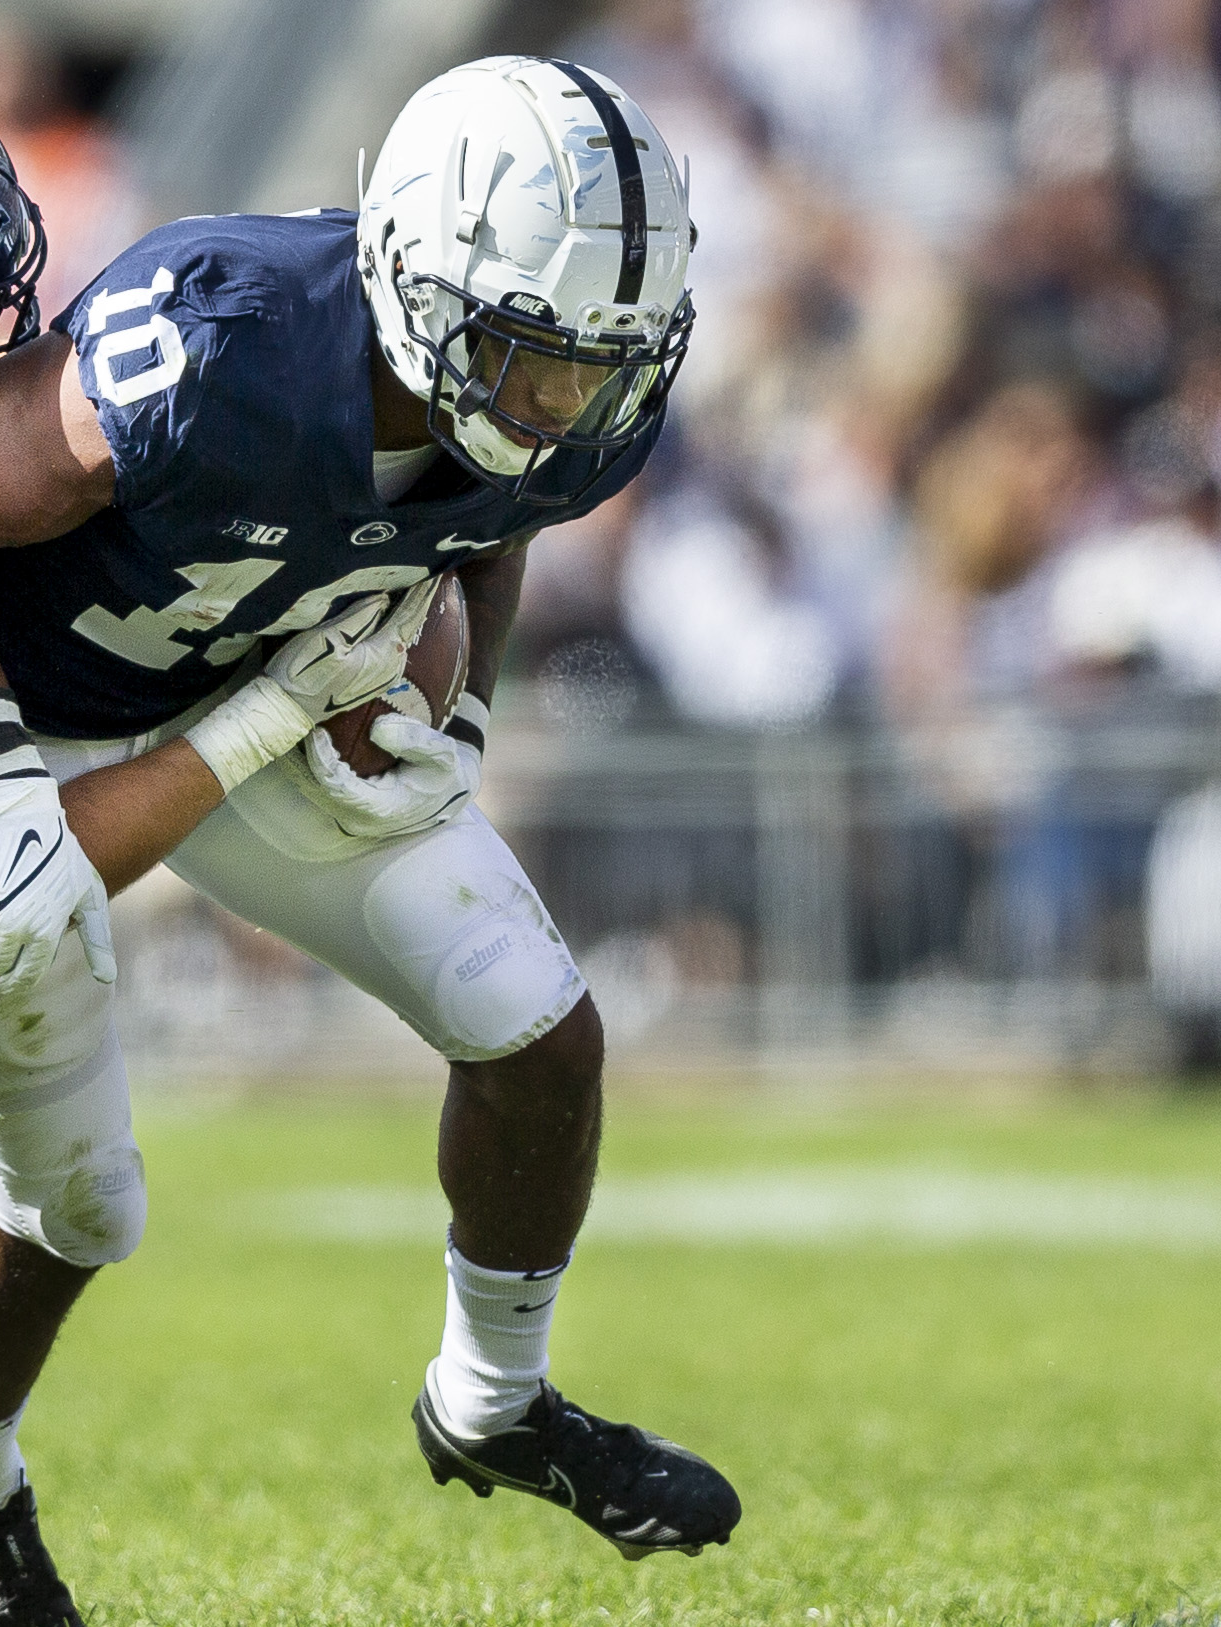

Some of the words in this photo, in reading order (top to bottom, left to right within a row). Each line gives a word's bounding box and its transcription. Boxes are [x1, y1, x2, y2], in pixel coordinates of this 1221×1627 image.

[508, 293, 548, 316] NIKE
[84, 266, 188, 408] 10
[454, 932, 513, 982] schutt
